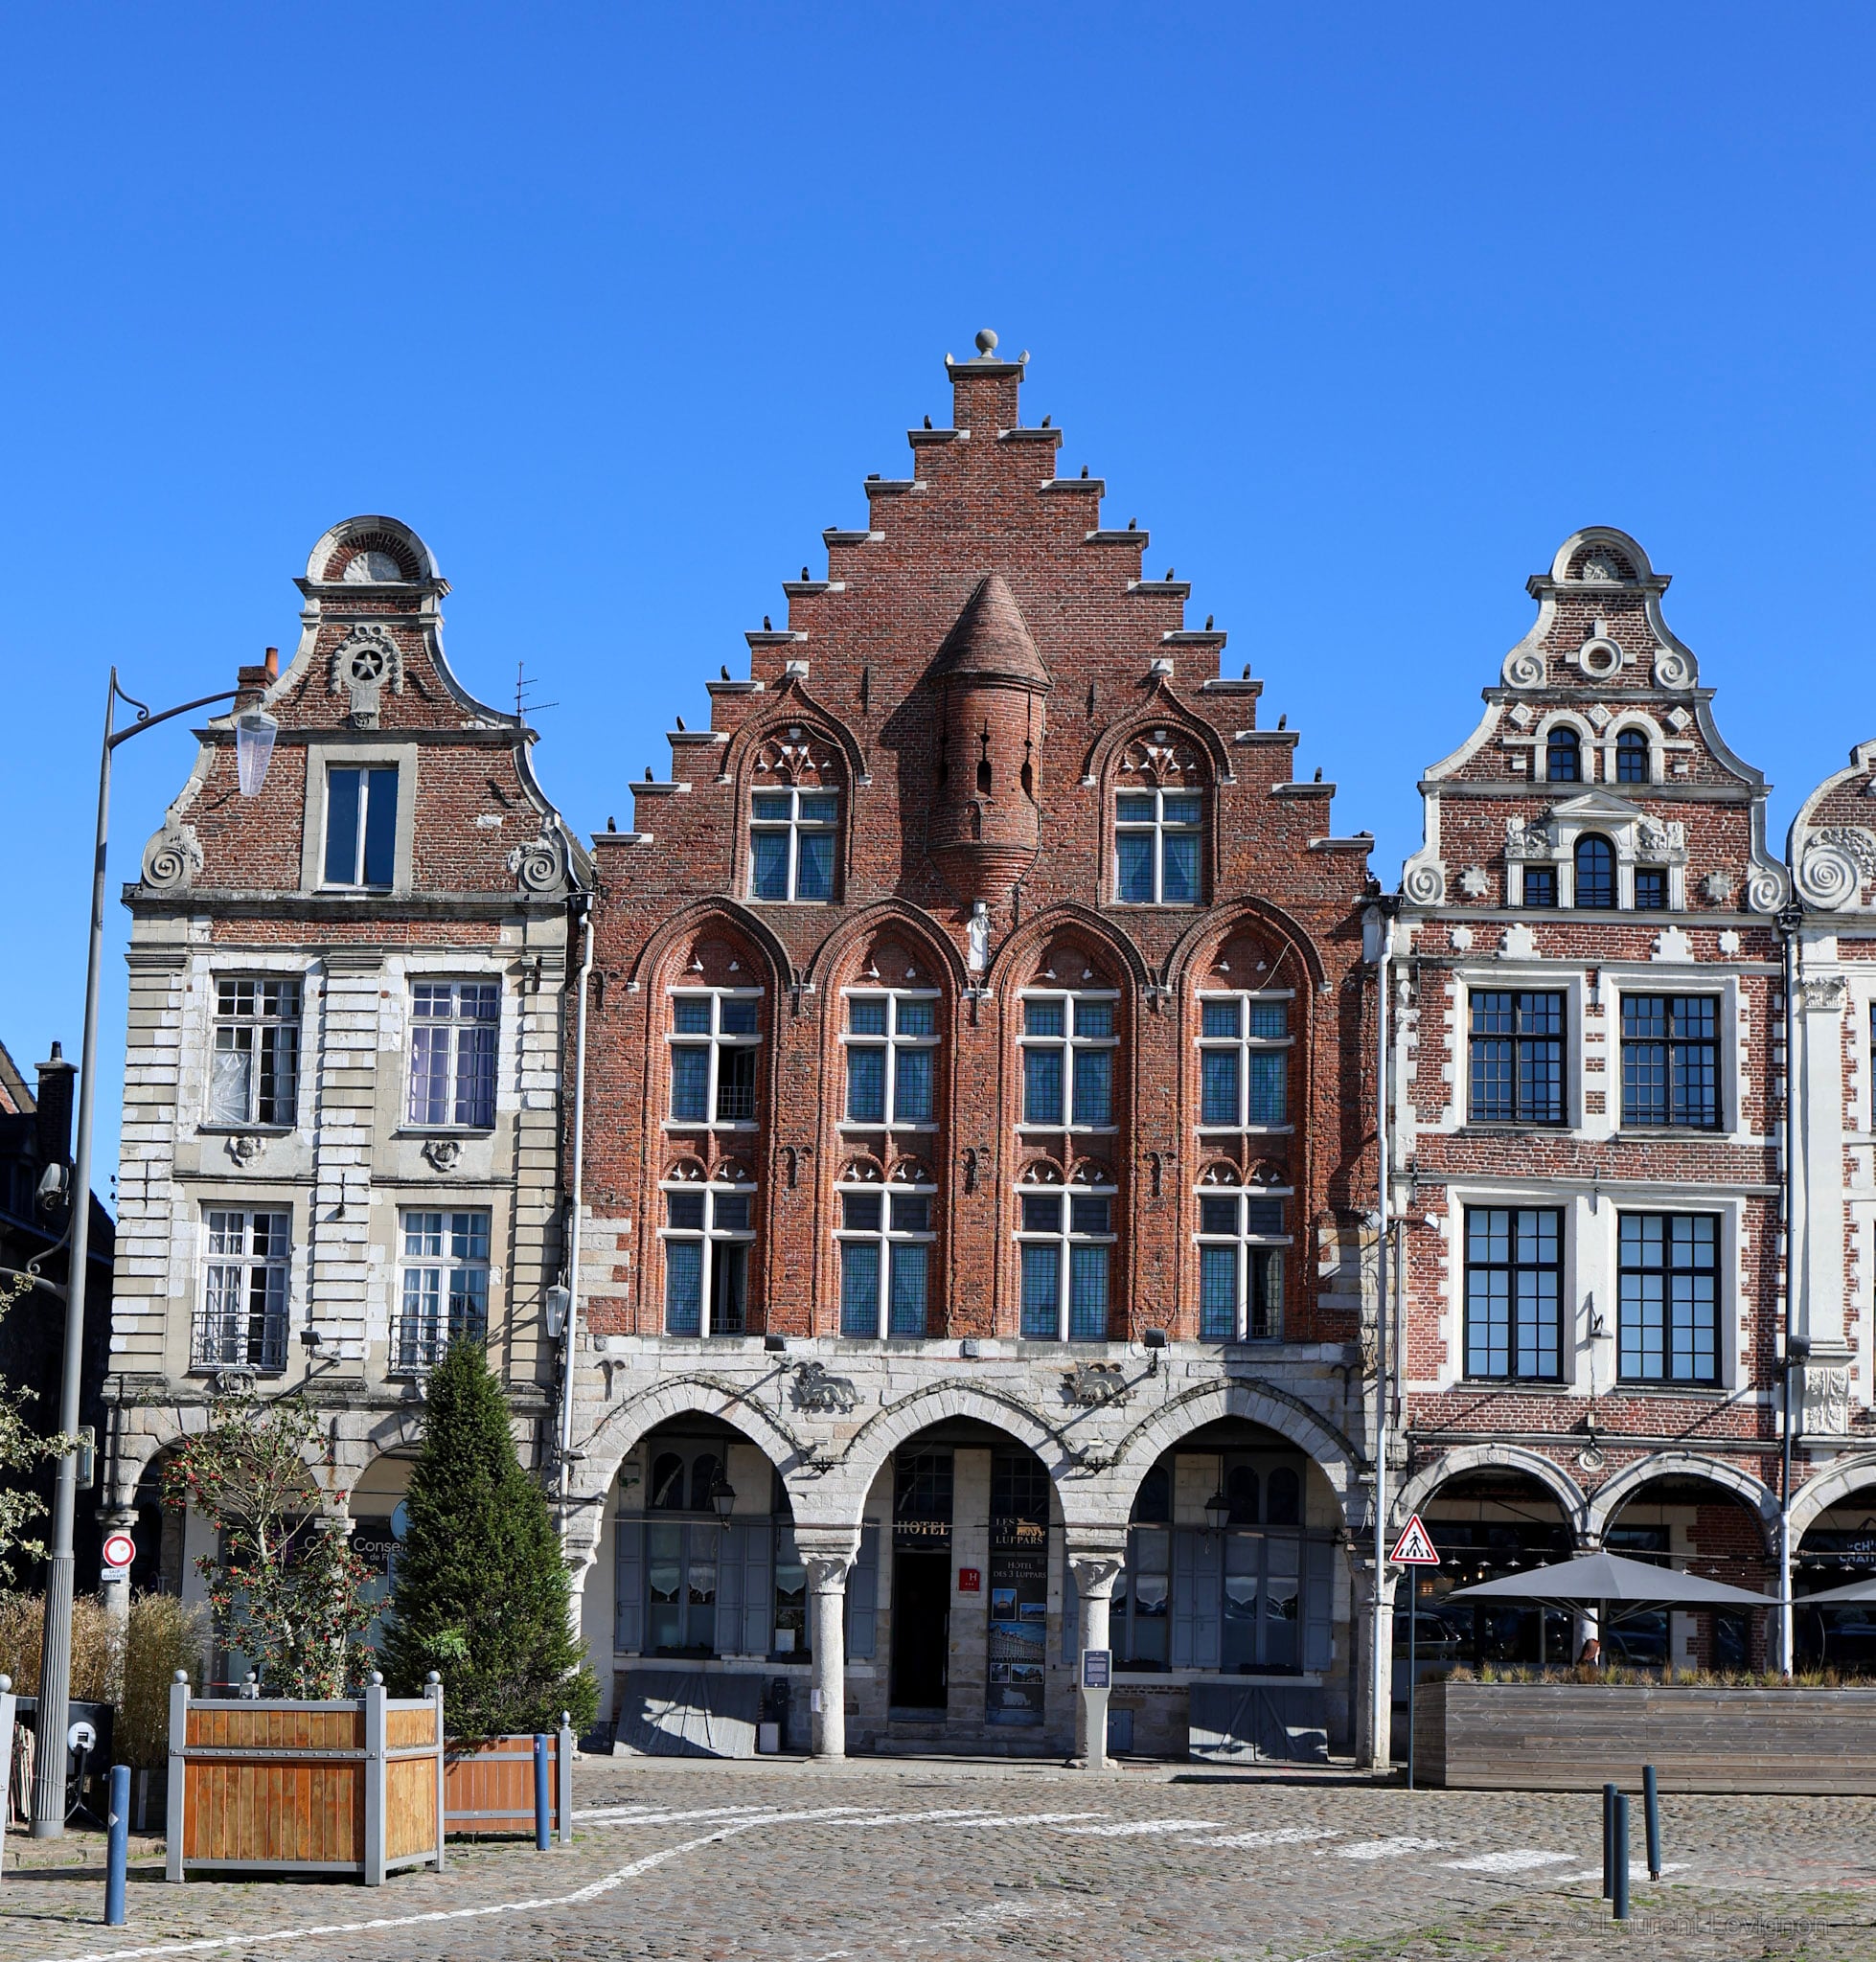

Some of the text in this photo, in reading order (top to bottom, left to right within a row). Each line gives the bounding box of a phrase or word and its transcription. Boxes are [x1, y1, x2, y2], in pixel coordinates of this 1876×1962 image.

[995, 1517, 1016, 1526] LES
[897, 1520, 949, 1536] HOTEL
[1002, 1525, 1008, 1535] 3
[995, 1535, 1043, 1544] LUPPARS
[370, 1552, 380, 1562] de
[969, 1572, 977, 1582] H
[1016, 1570, 1046, 1579] LUPPARS
